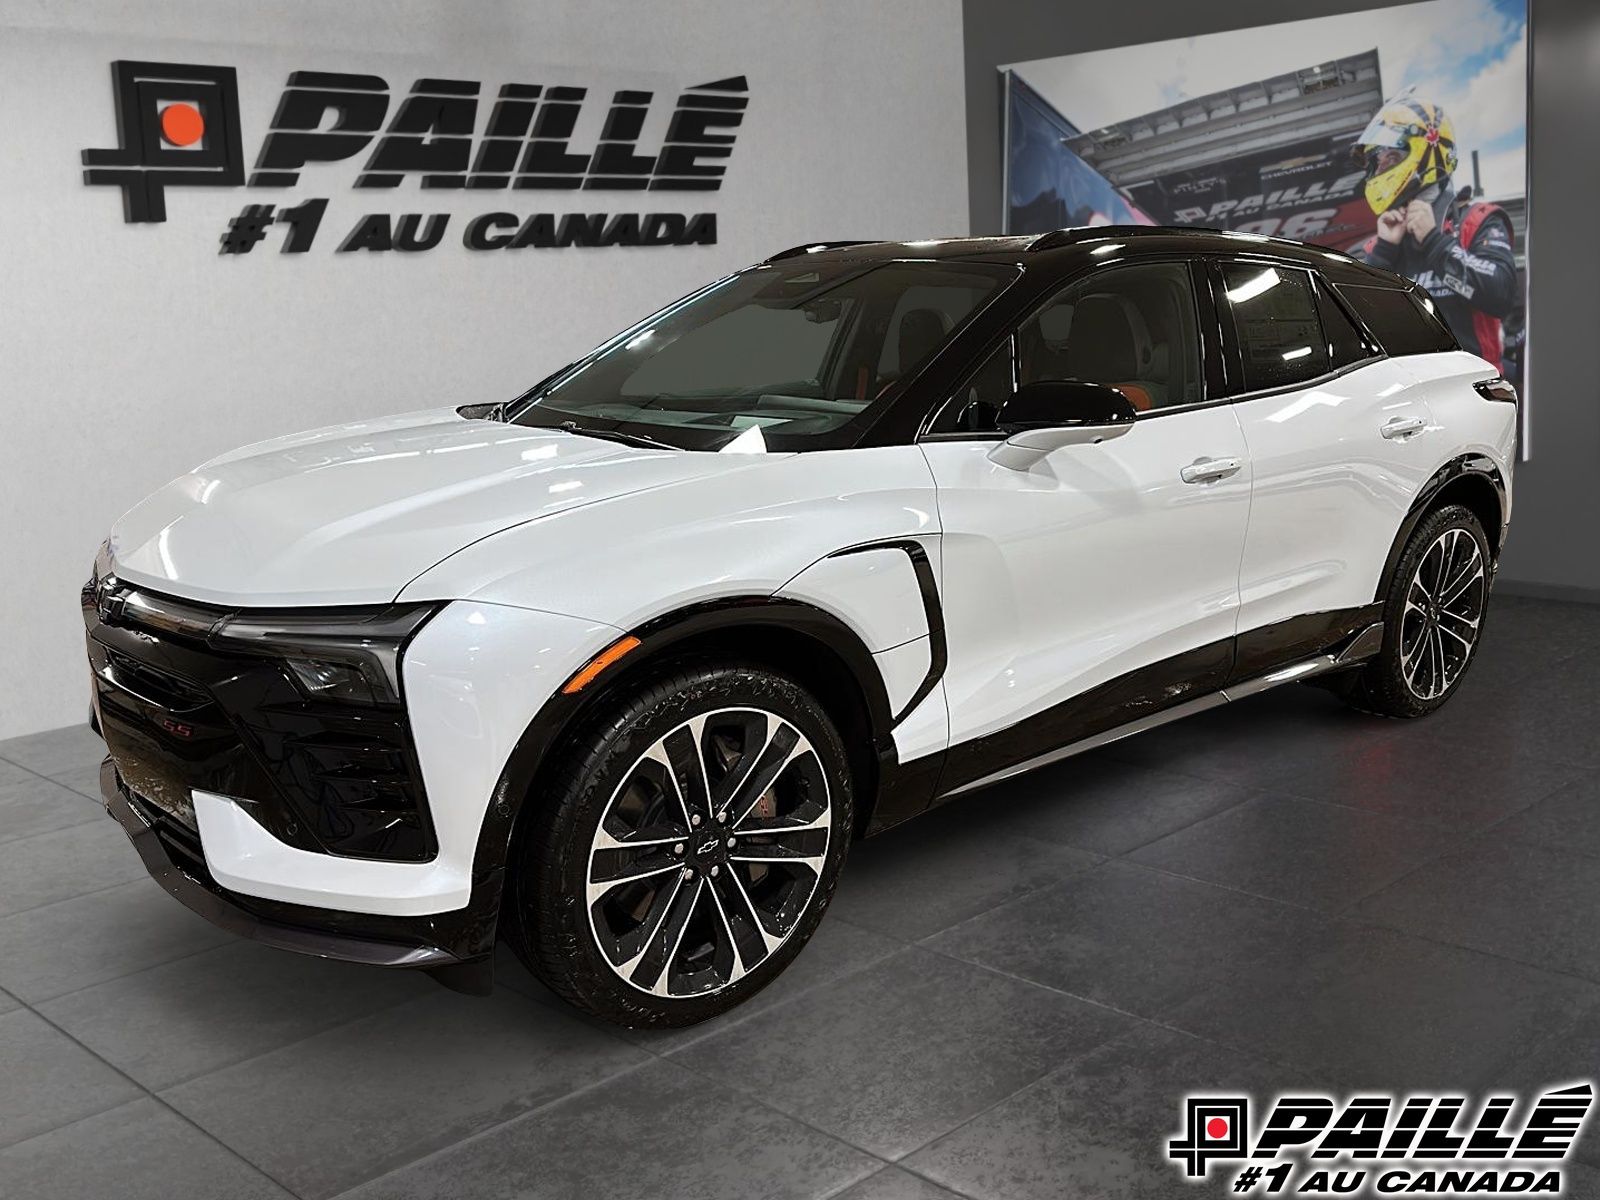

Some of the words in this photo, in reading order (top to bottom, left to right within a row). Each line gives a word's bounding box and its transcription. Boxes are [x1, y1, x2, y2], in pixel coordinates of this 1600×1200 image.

[246, 71, 749, 191] PAILLÉ
[1261, 161, 1333, 180] CHEVROLET
[218, 198, 330, 255] #1
[335, 213, 451, 254] AU
[462, 212, 718, 251] CANADA
